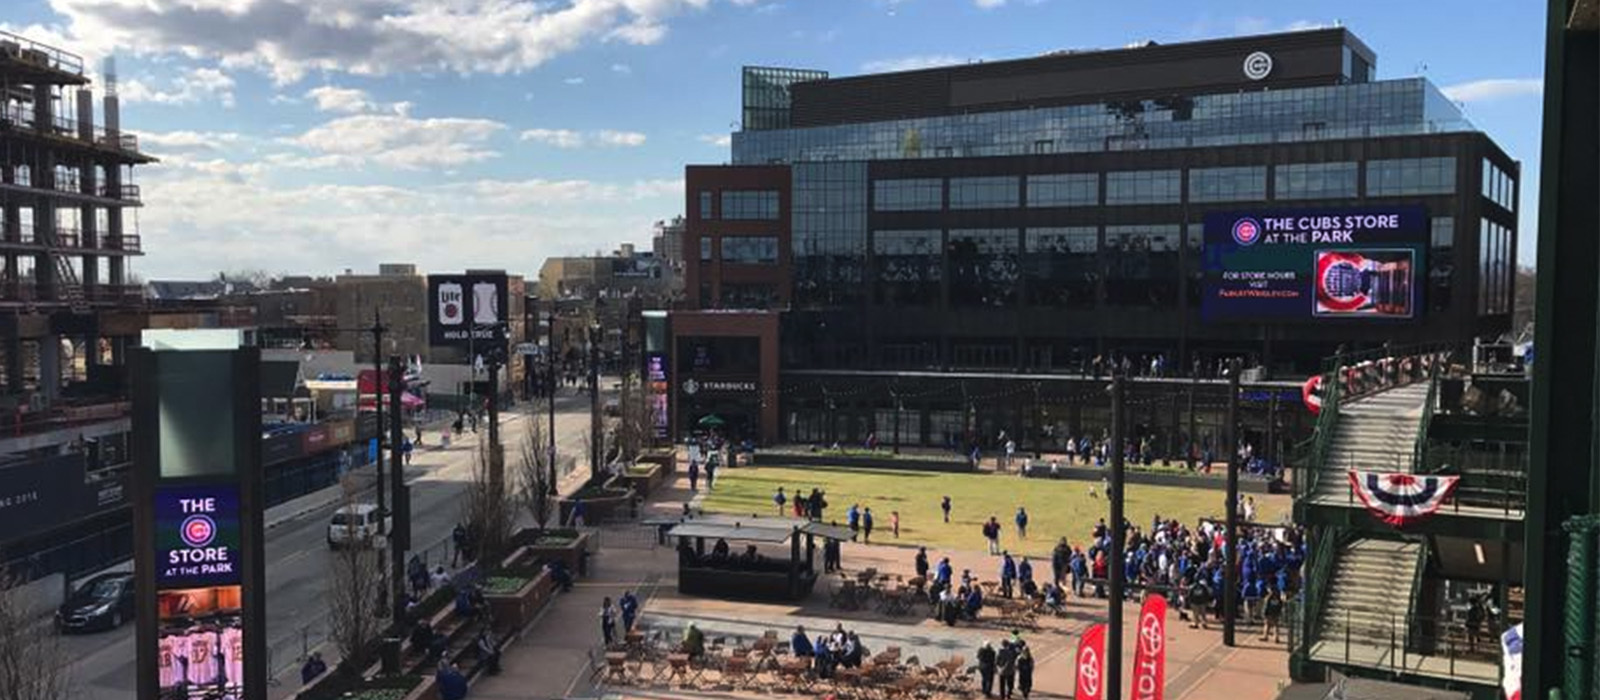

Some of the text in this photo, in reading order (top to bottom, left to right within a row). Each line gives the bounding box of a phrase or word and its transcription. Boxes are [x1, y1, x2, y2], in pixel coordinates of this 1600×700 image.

[1264, 214, 1399, 230] THE CUBS STORE
[1264, 230, 1353, 244] AT THE PARK
[1222, 271, 1296, 280] FOR STORE HOURS
[444, 331, 494, 339] HOLD TRUE
[703, 382, 756, 391] STARBUCKS
[180, 498, 216, 512] THE
[169, 547, 228, 563] STORE
[165, 563, 232, 576] AT THE PARK
